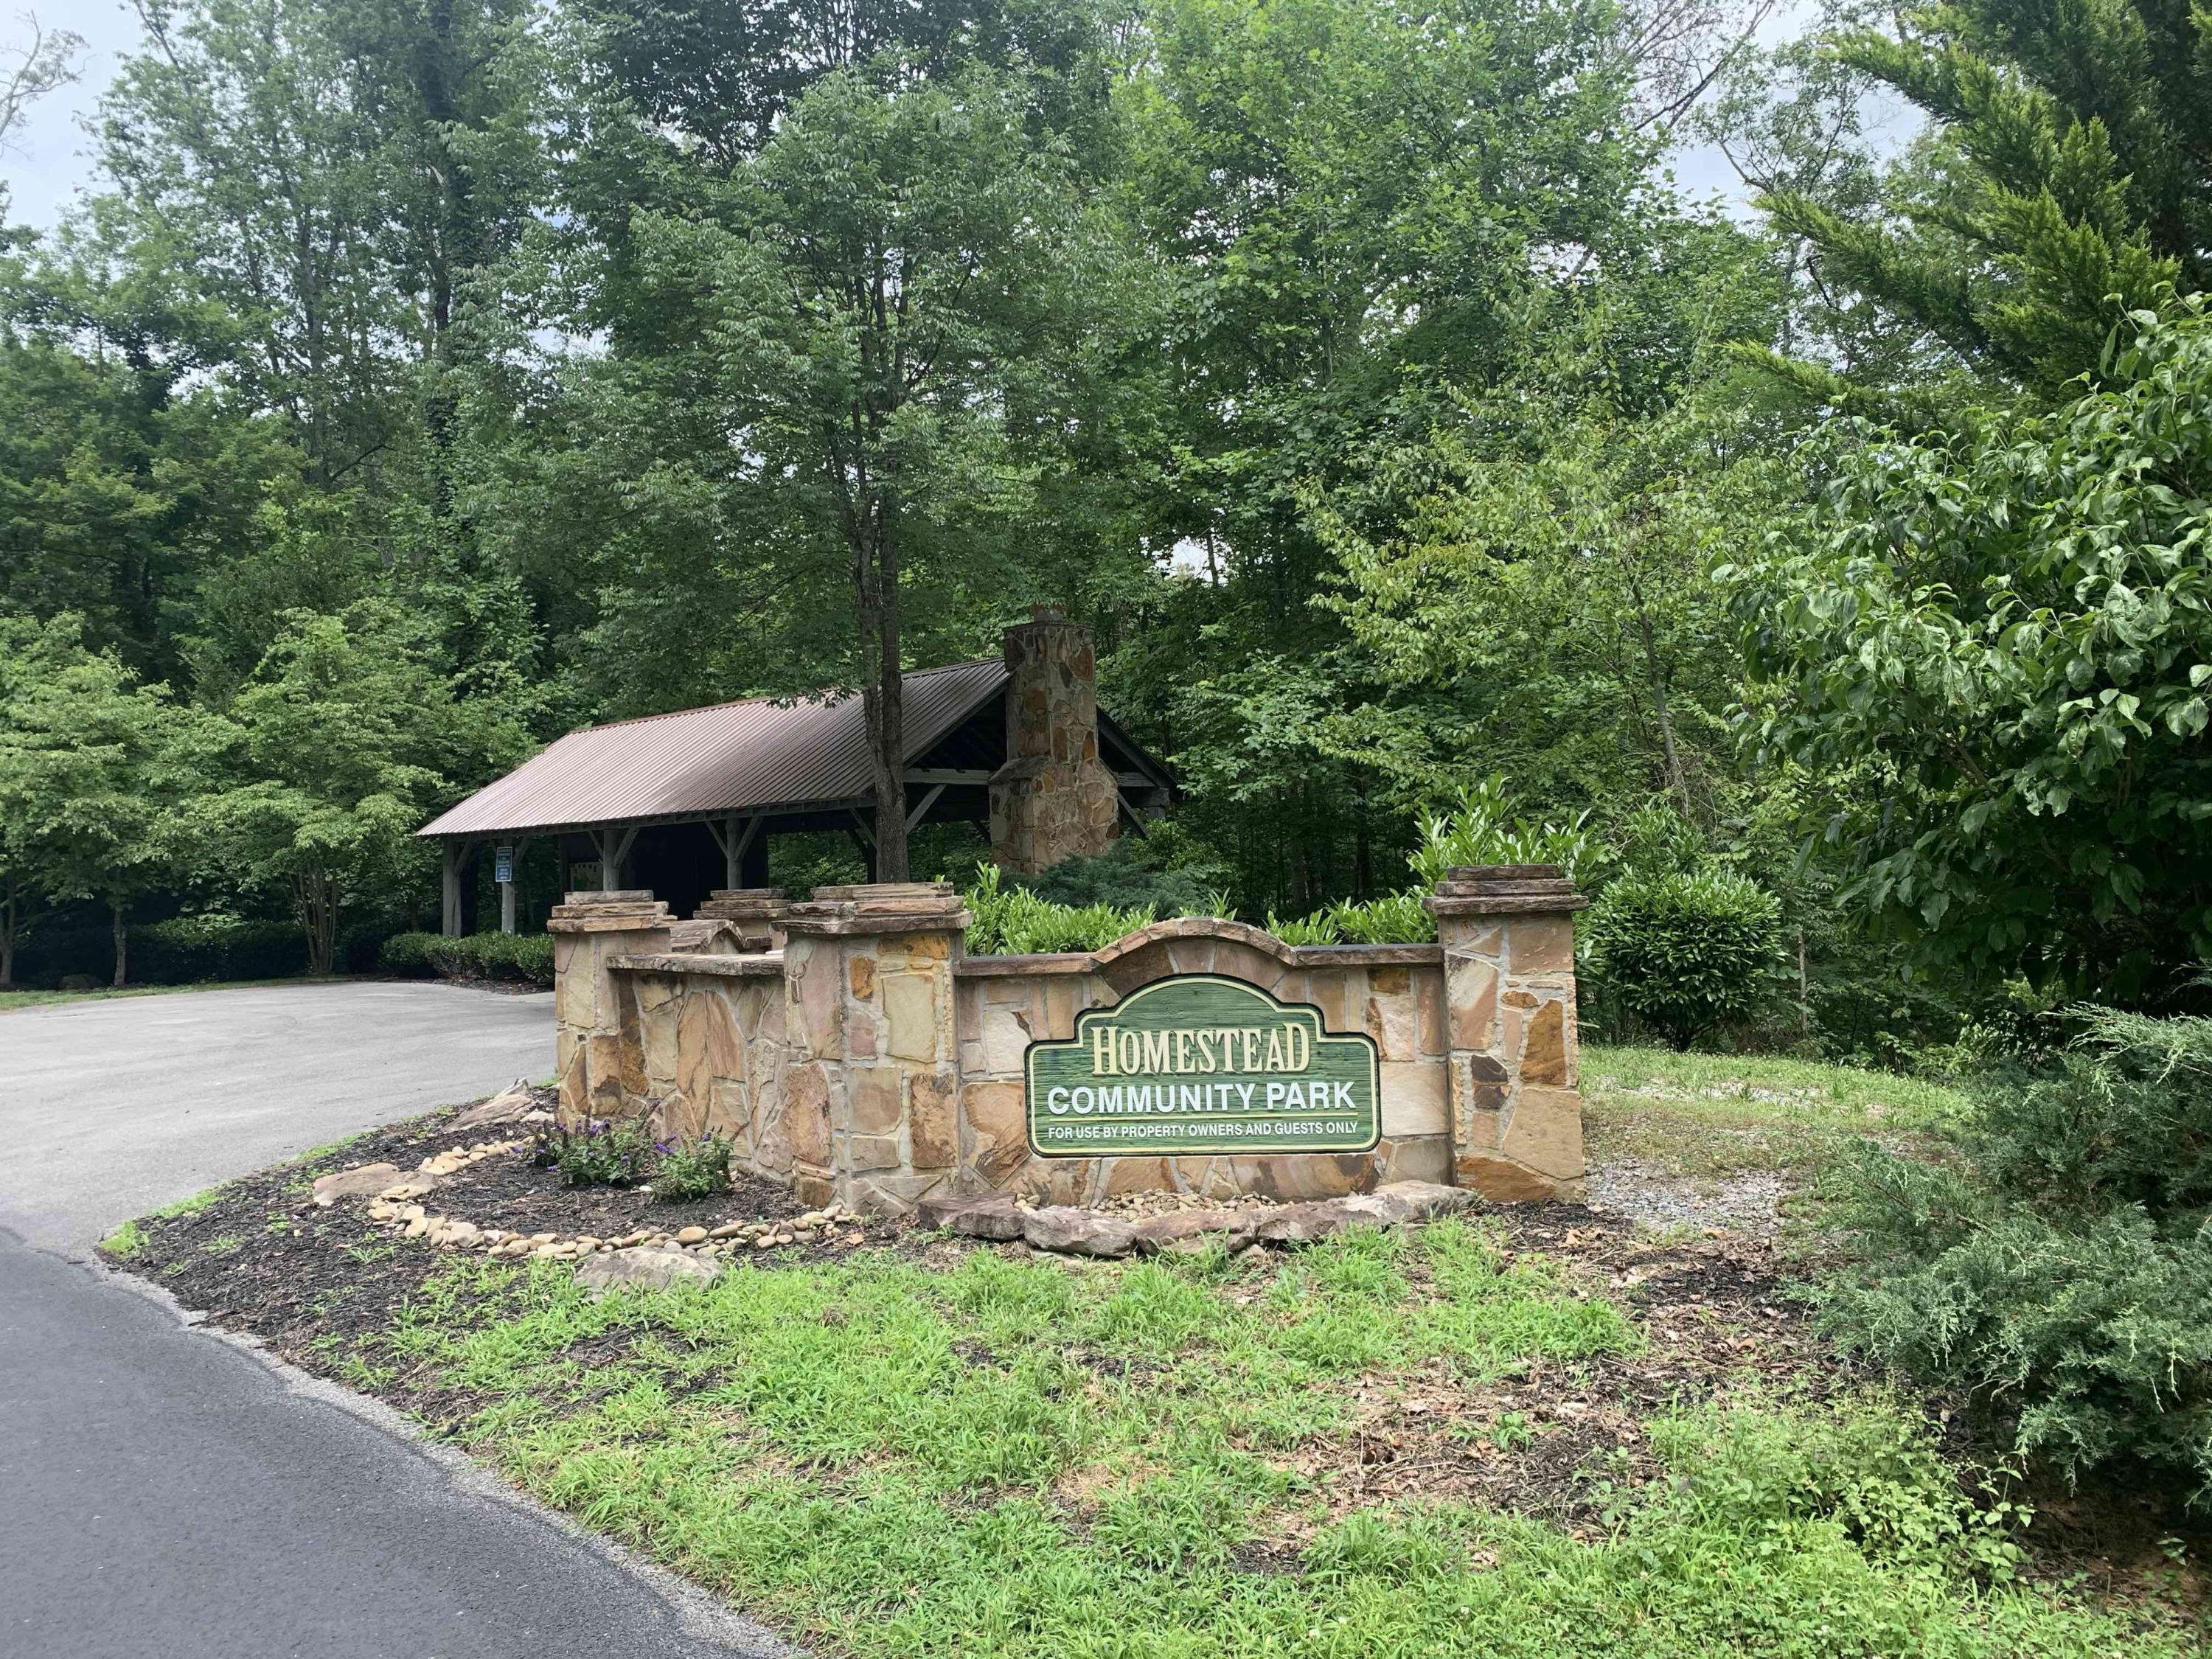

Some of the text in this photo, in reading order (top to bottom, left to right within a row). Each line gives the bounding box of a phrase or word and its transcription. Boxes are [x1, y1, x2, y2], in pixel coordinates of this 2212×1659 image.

[1090, 1022, 1310, 1077] HOMESTEAD
[1047, 1080, 1357, 1116] COMMUNITY PARK
[1048, 1120, 1359, 1139] FOR USE BY PROPERTY OWNERS AND GUESTS ONLY
